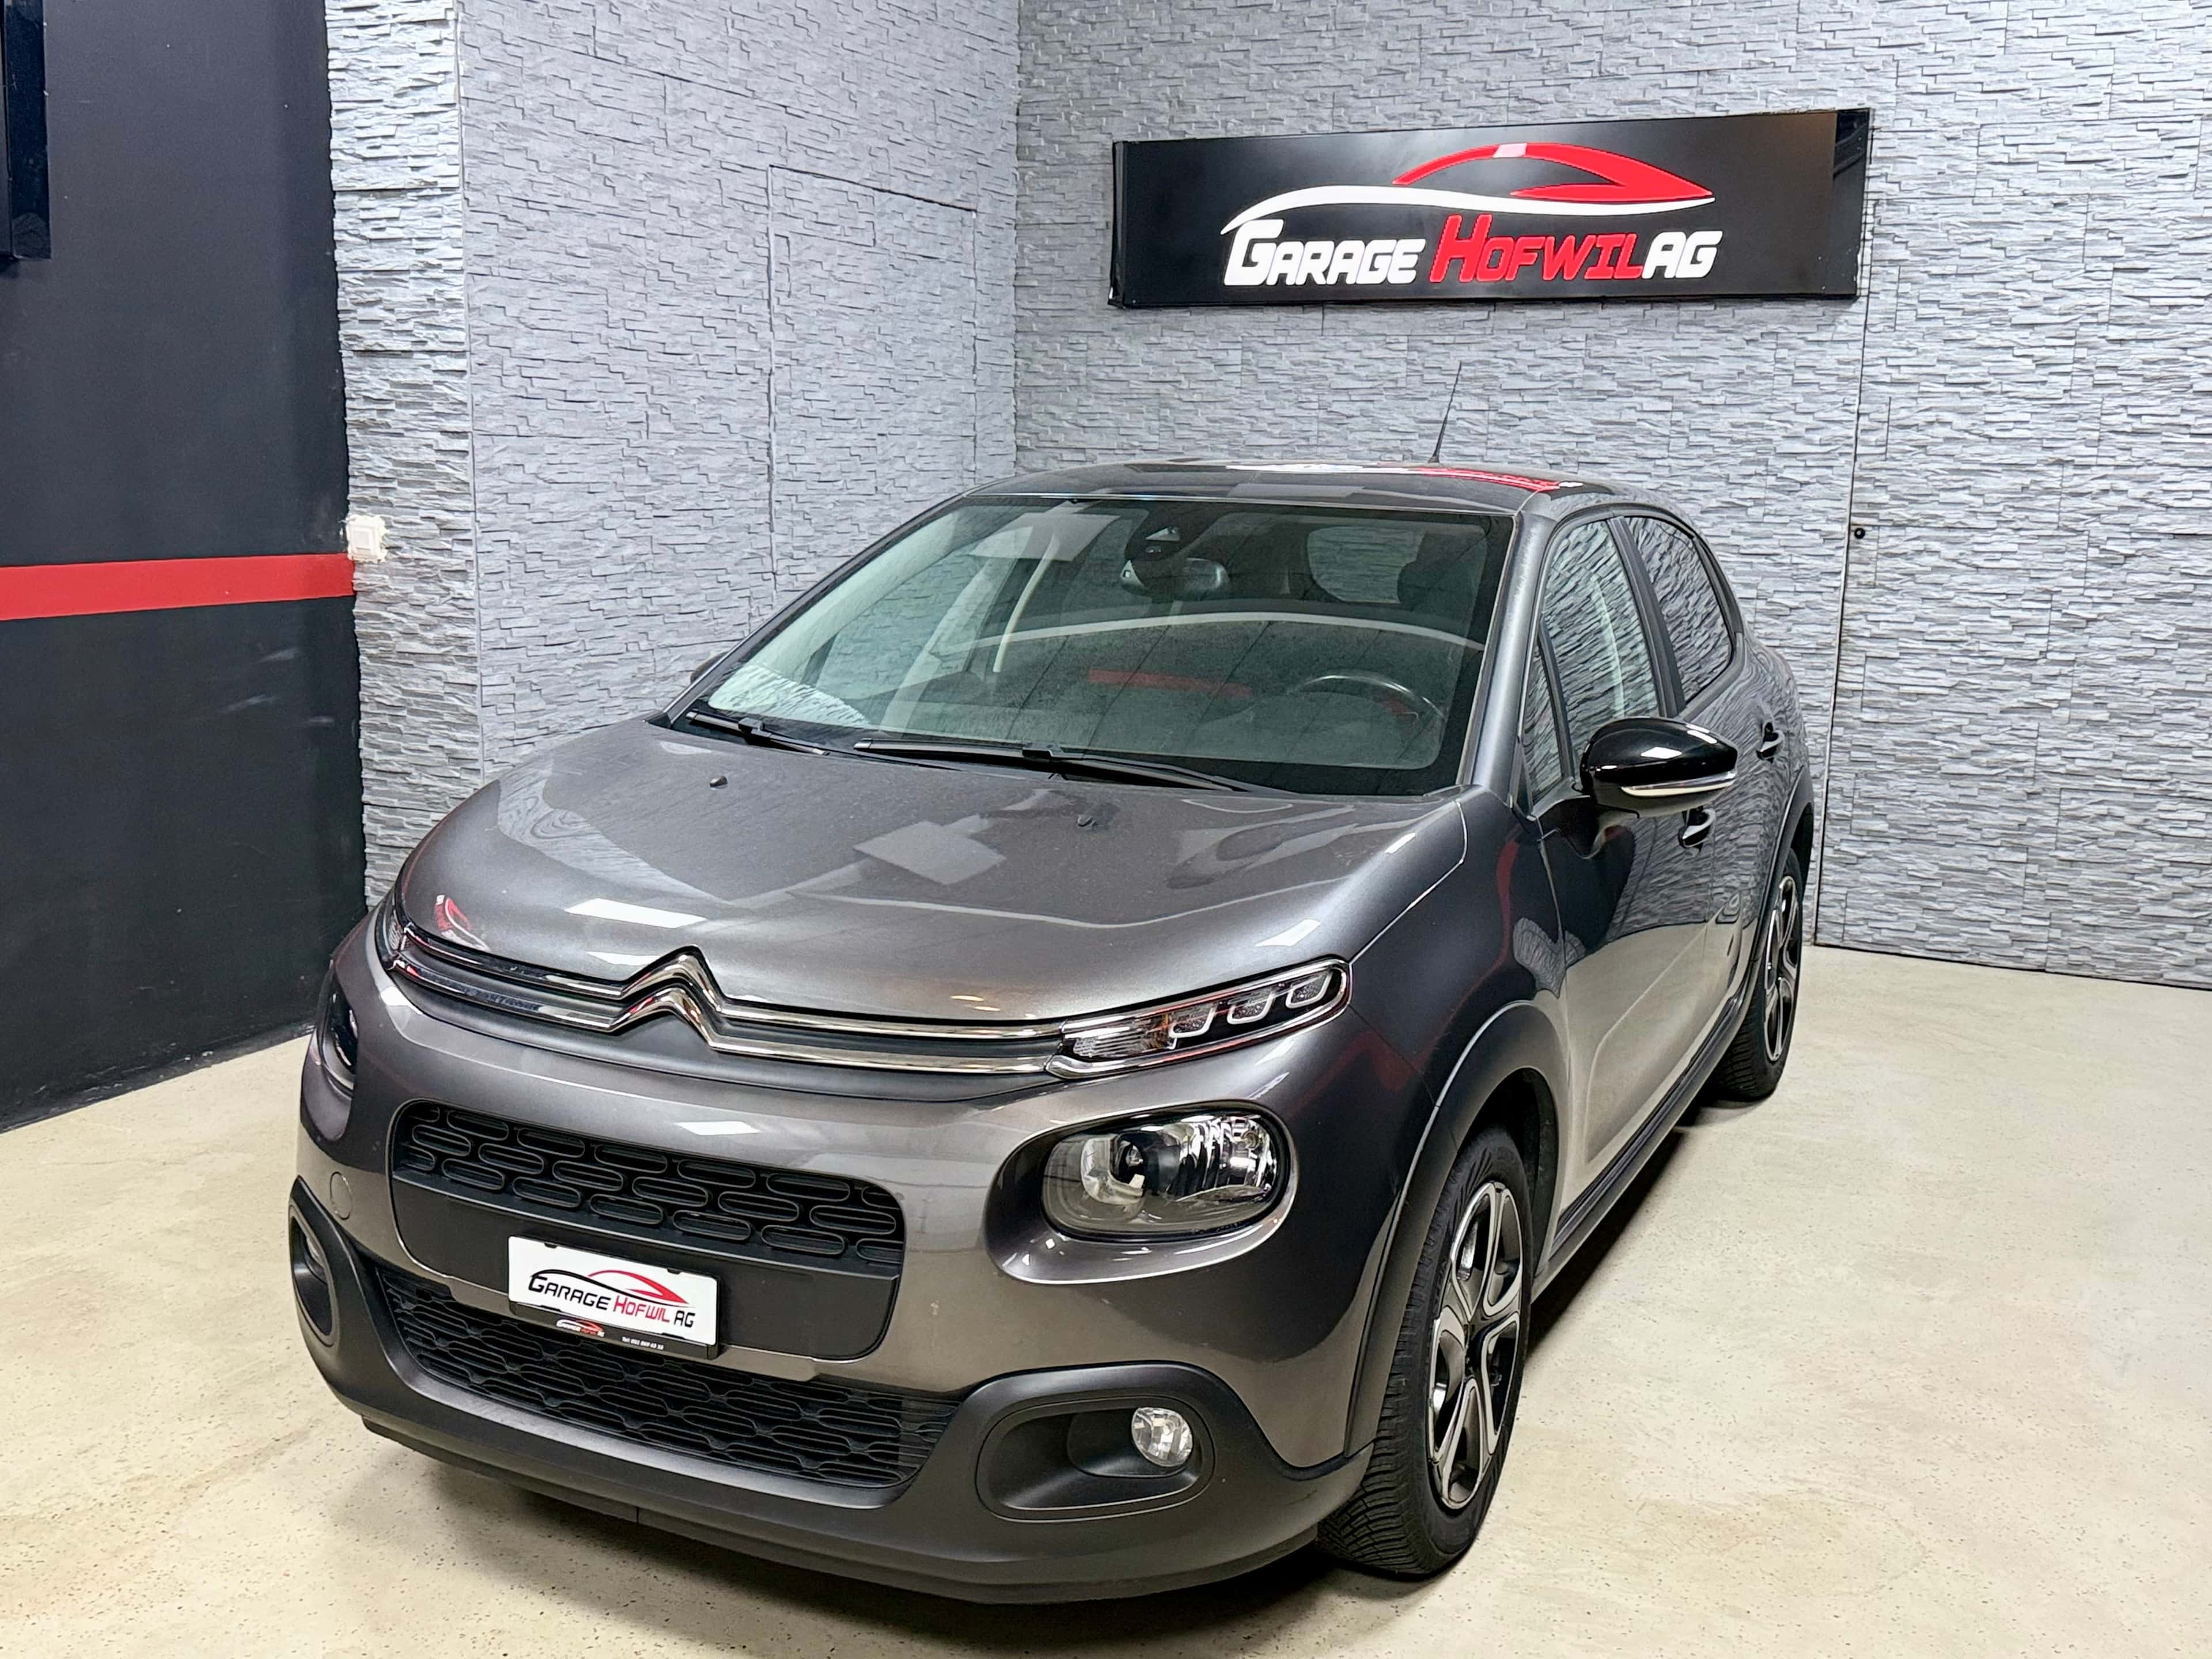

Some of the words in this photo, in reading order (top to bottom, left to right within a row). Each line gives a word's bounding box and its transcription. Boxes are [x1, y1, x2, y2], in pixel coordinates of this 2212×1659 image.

[1224, 218, 1426, 286] GARAGE
[528, 1275, 611, 1310] GARAGE
[613, 1296, 670, 1323] HOFWIL
[673, 1310, 696, 1328] AG
